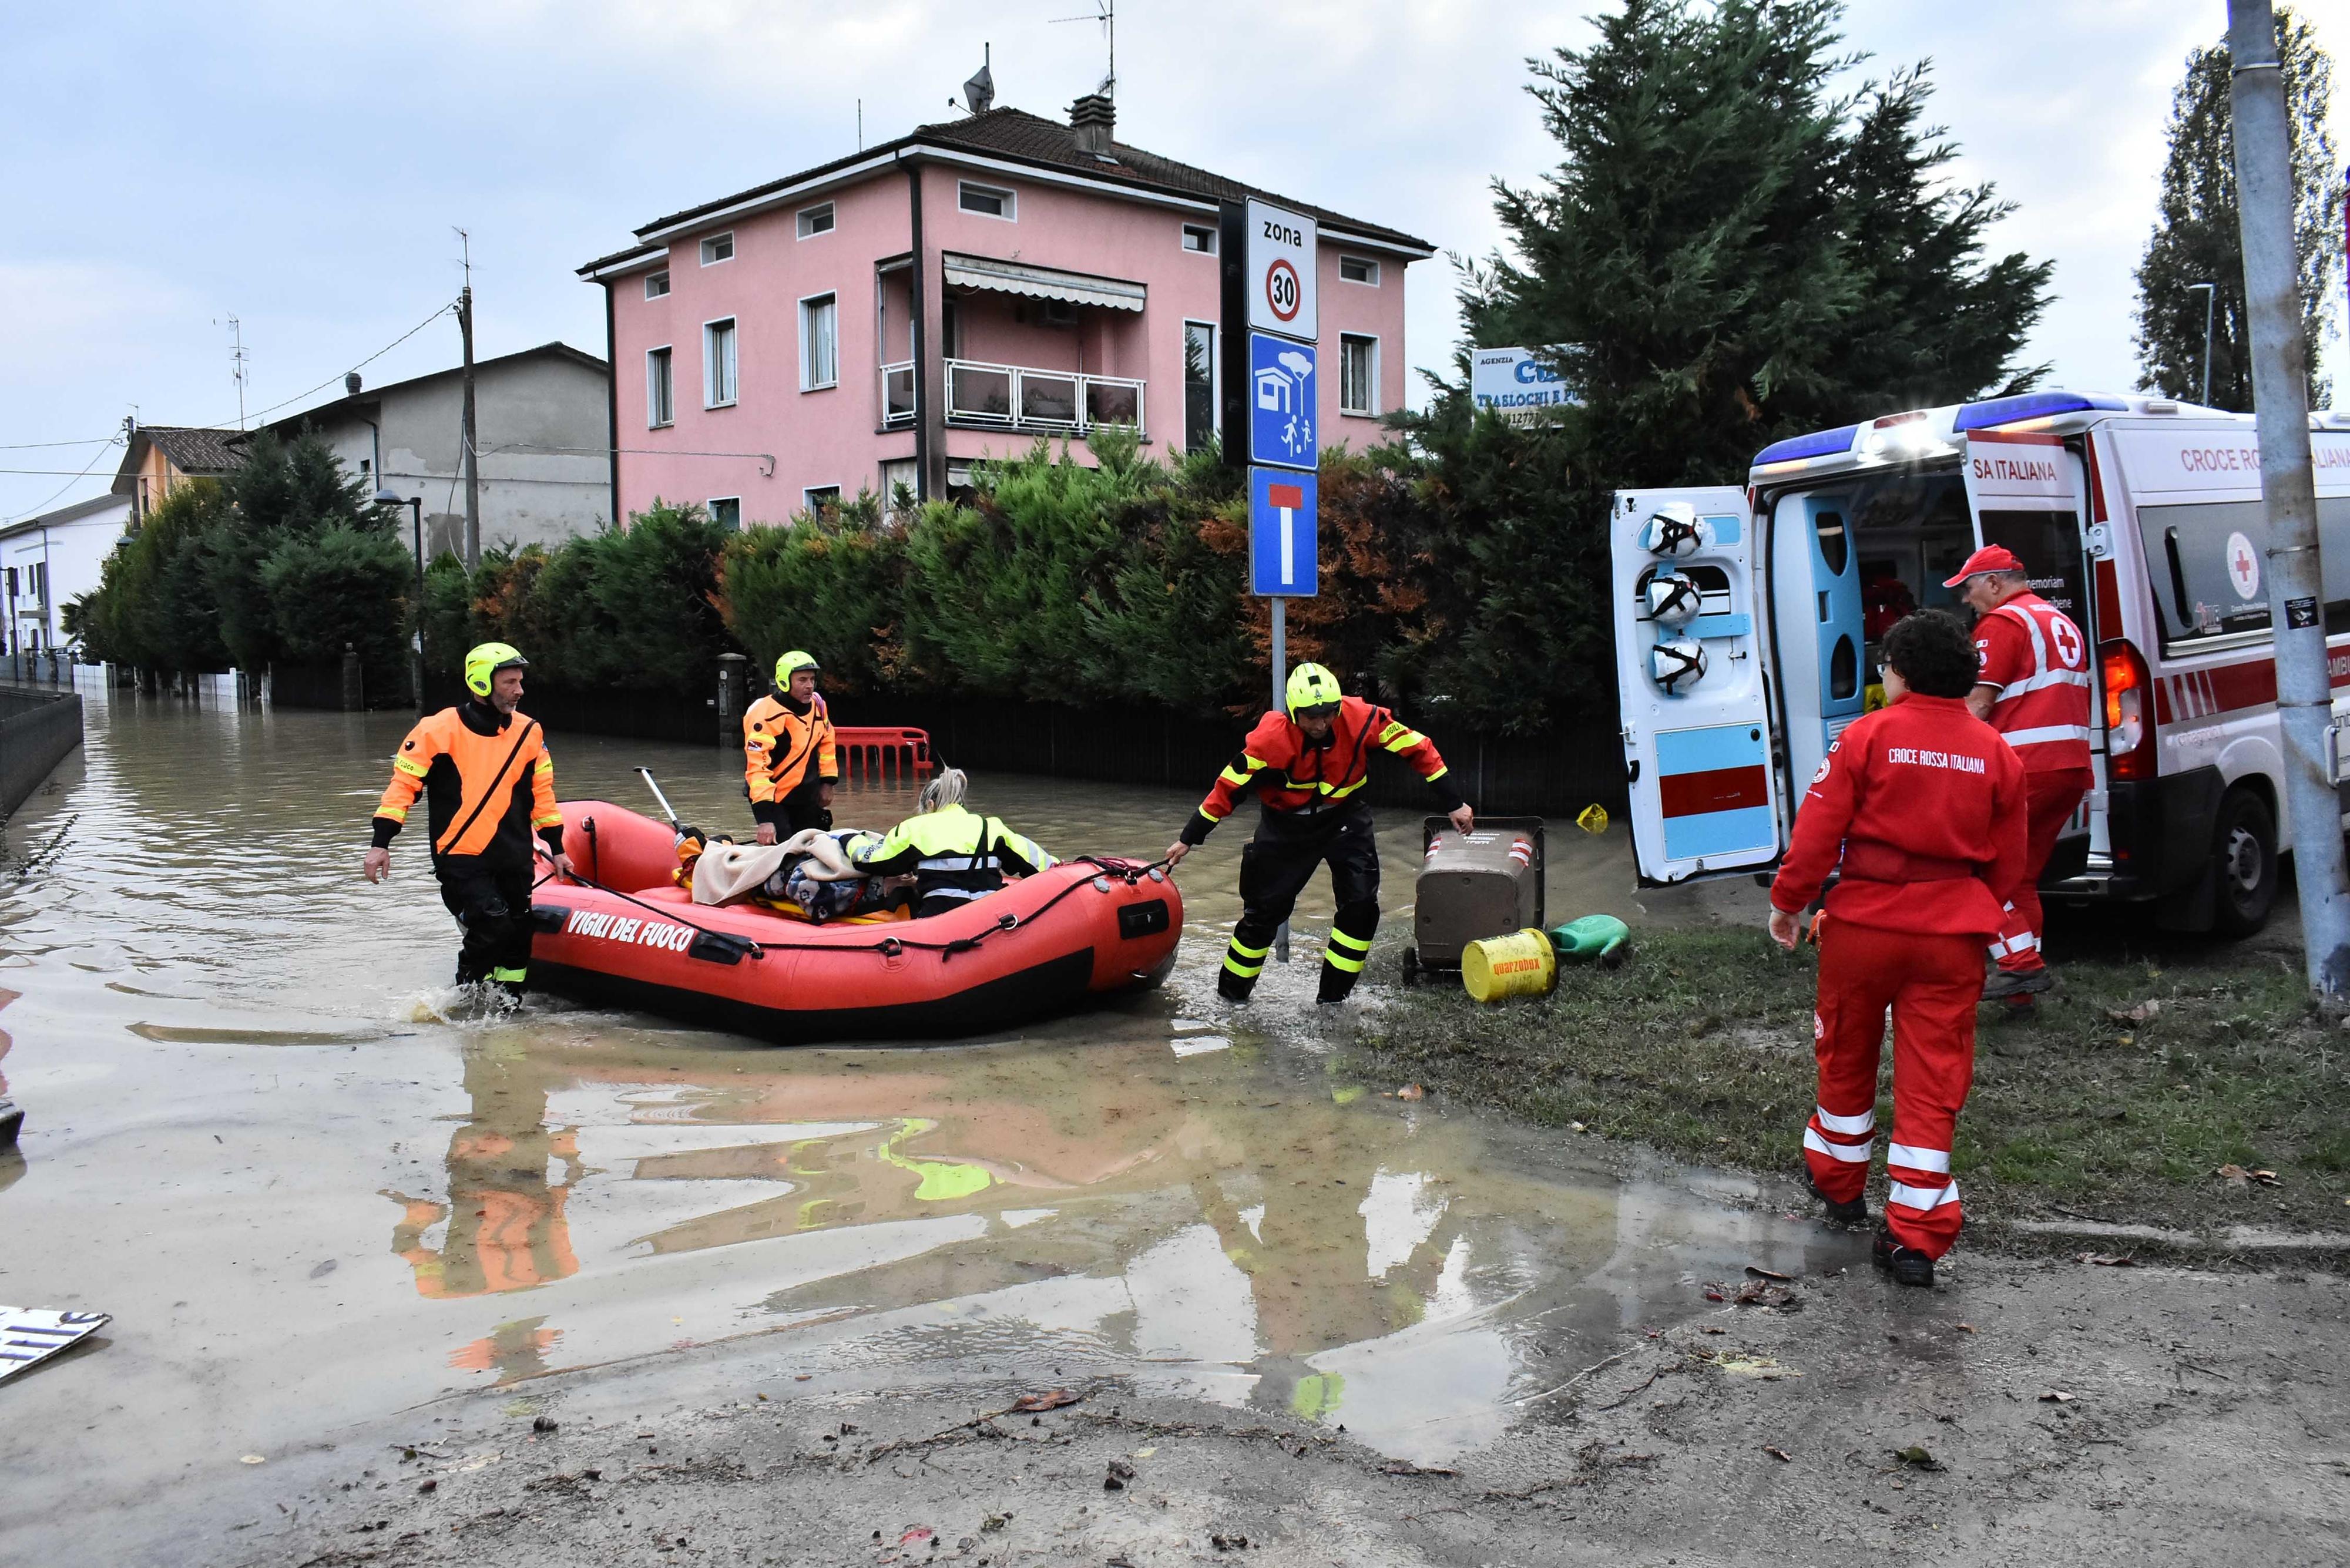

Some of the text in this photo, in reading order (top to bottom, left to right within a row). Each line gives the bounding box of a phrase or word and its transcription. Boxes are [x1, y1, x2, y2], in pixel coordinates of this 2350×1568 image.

[1264, 221, 1302, 247] zona
[1274, 274, 1294, 307] 30
[1480, 357, 1513, 365] AGENZIA
[1564, 389, 1580, 402] PU
[1973, 459, 2057, 481] SA ITALIANA
[2181, 449, 2239, 471] CROCE
[2240, 449, 2261, 471] RO
[1889, 748, 1985, 774] CROCE ROSSA ITALIANA
[568, 911, 695, 952] VIGILI DEL FUOCO
[1493, 958, 1540, 975] quarzobox
